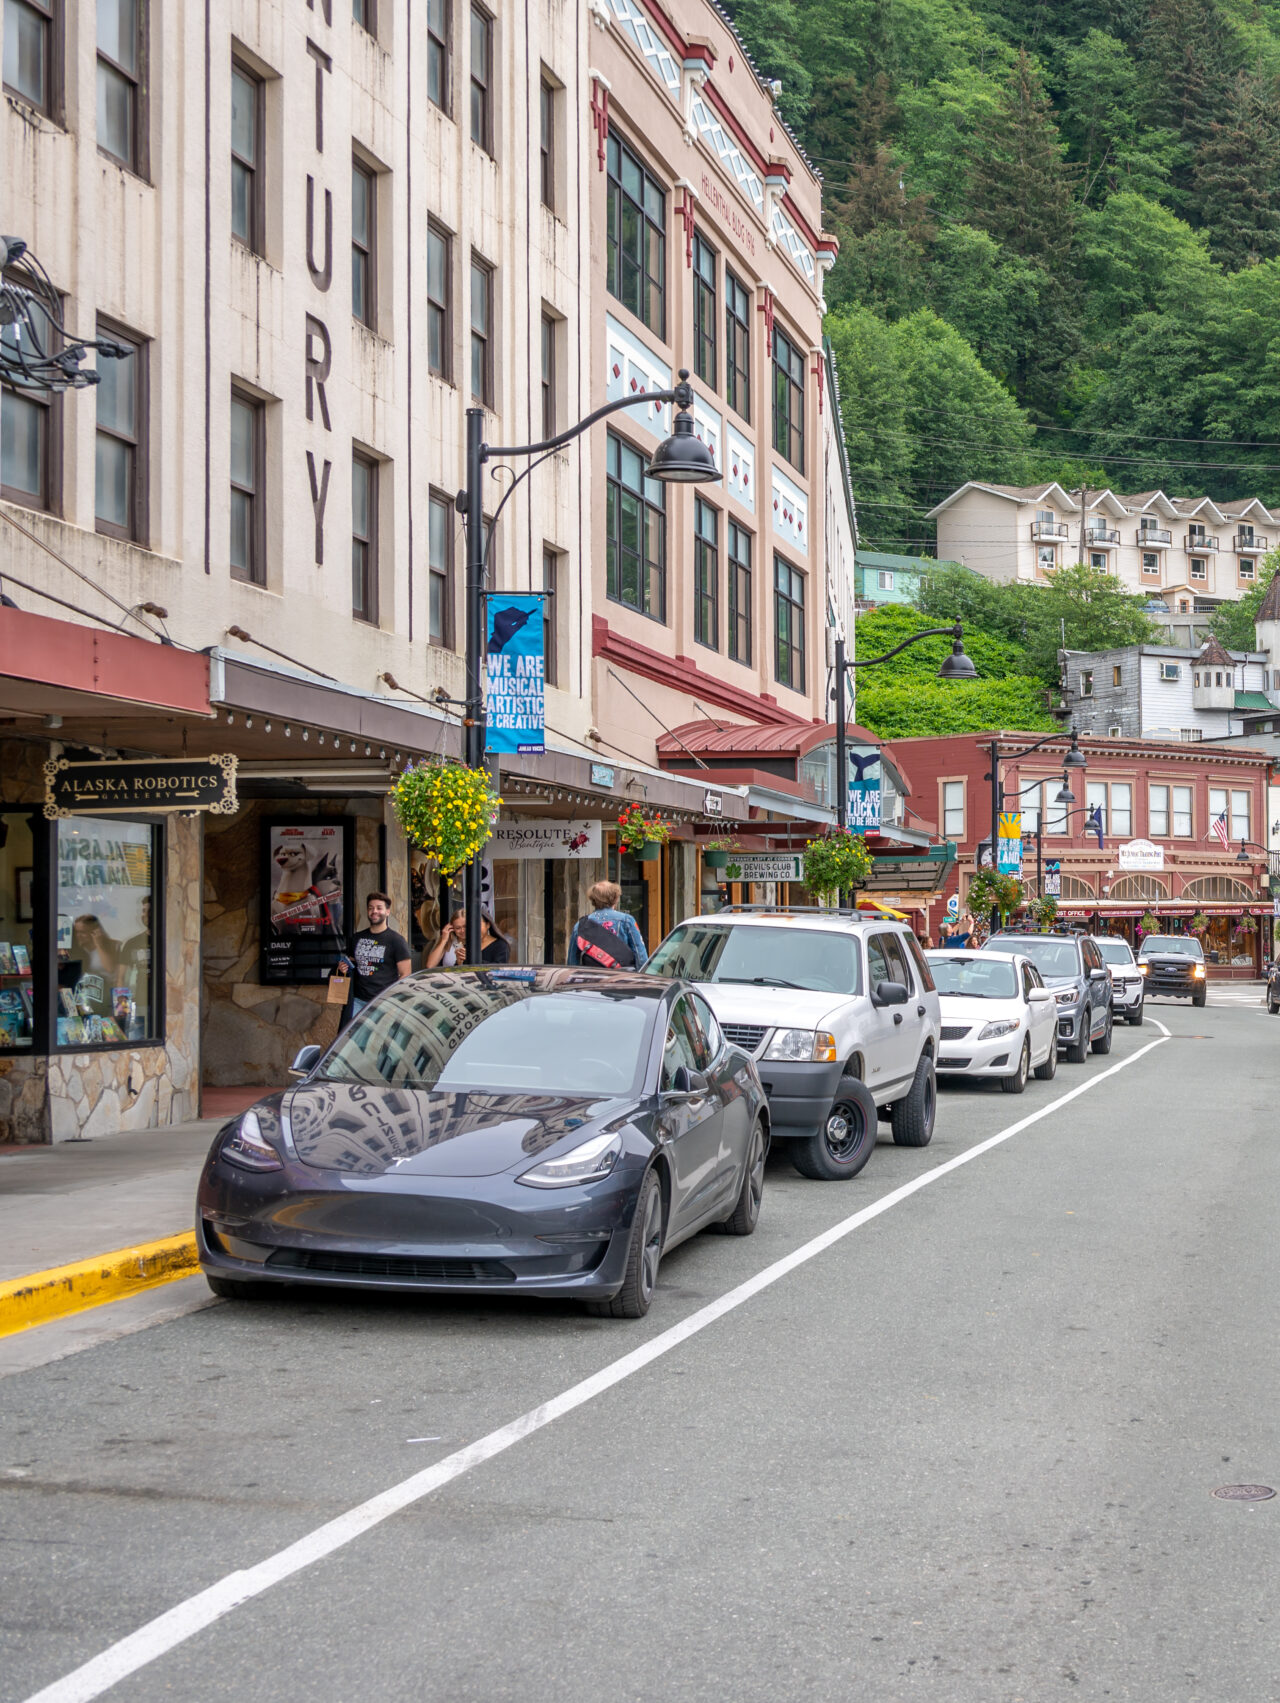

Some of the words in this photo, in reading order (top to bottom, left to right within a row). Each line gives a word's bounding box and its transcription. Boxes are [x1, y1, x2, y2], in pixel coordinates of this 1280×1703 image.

[487, 654, 512, 676] WE
[515, 655, 544, 677] ARE
[487, 677, 544, 696] MUSICAL
[487, 695, 544, 714] ARTISTIC
[486, 713, 494, 728] &
[496, 713, 545, 730] CREATIVE
[61, 778, 128, 792] ALASKA
[134, 775, 218, 790] ROBOTICS
[102, 791, 171, 800] GALLERY
[848, 789, 861, 803] WE
[865, 789, 880, 803] ARE
[847, 801, 880, 818] LUCKY
[848, 816, 855, 826] TO
[856, 816, 864, 826] BE
[865, 817, 880, 827] HERE
[497, 829, 571, 840] RESOLUTE
[509, 839, 555, 853] Boutique
[997, 850, 1019, 864] LAND
[744, 862, 771, 871] DEVIL'S
[772, 862, 792, 871] CLUB
[744, 871, 778, 879] BREWING
[780, 871, 792, 879] CO.
